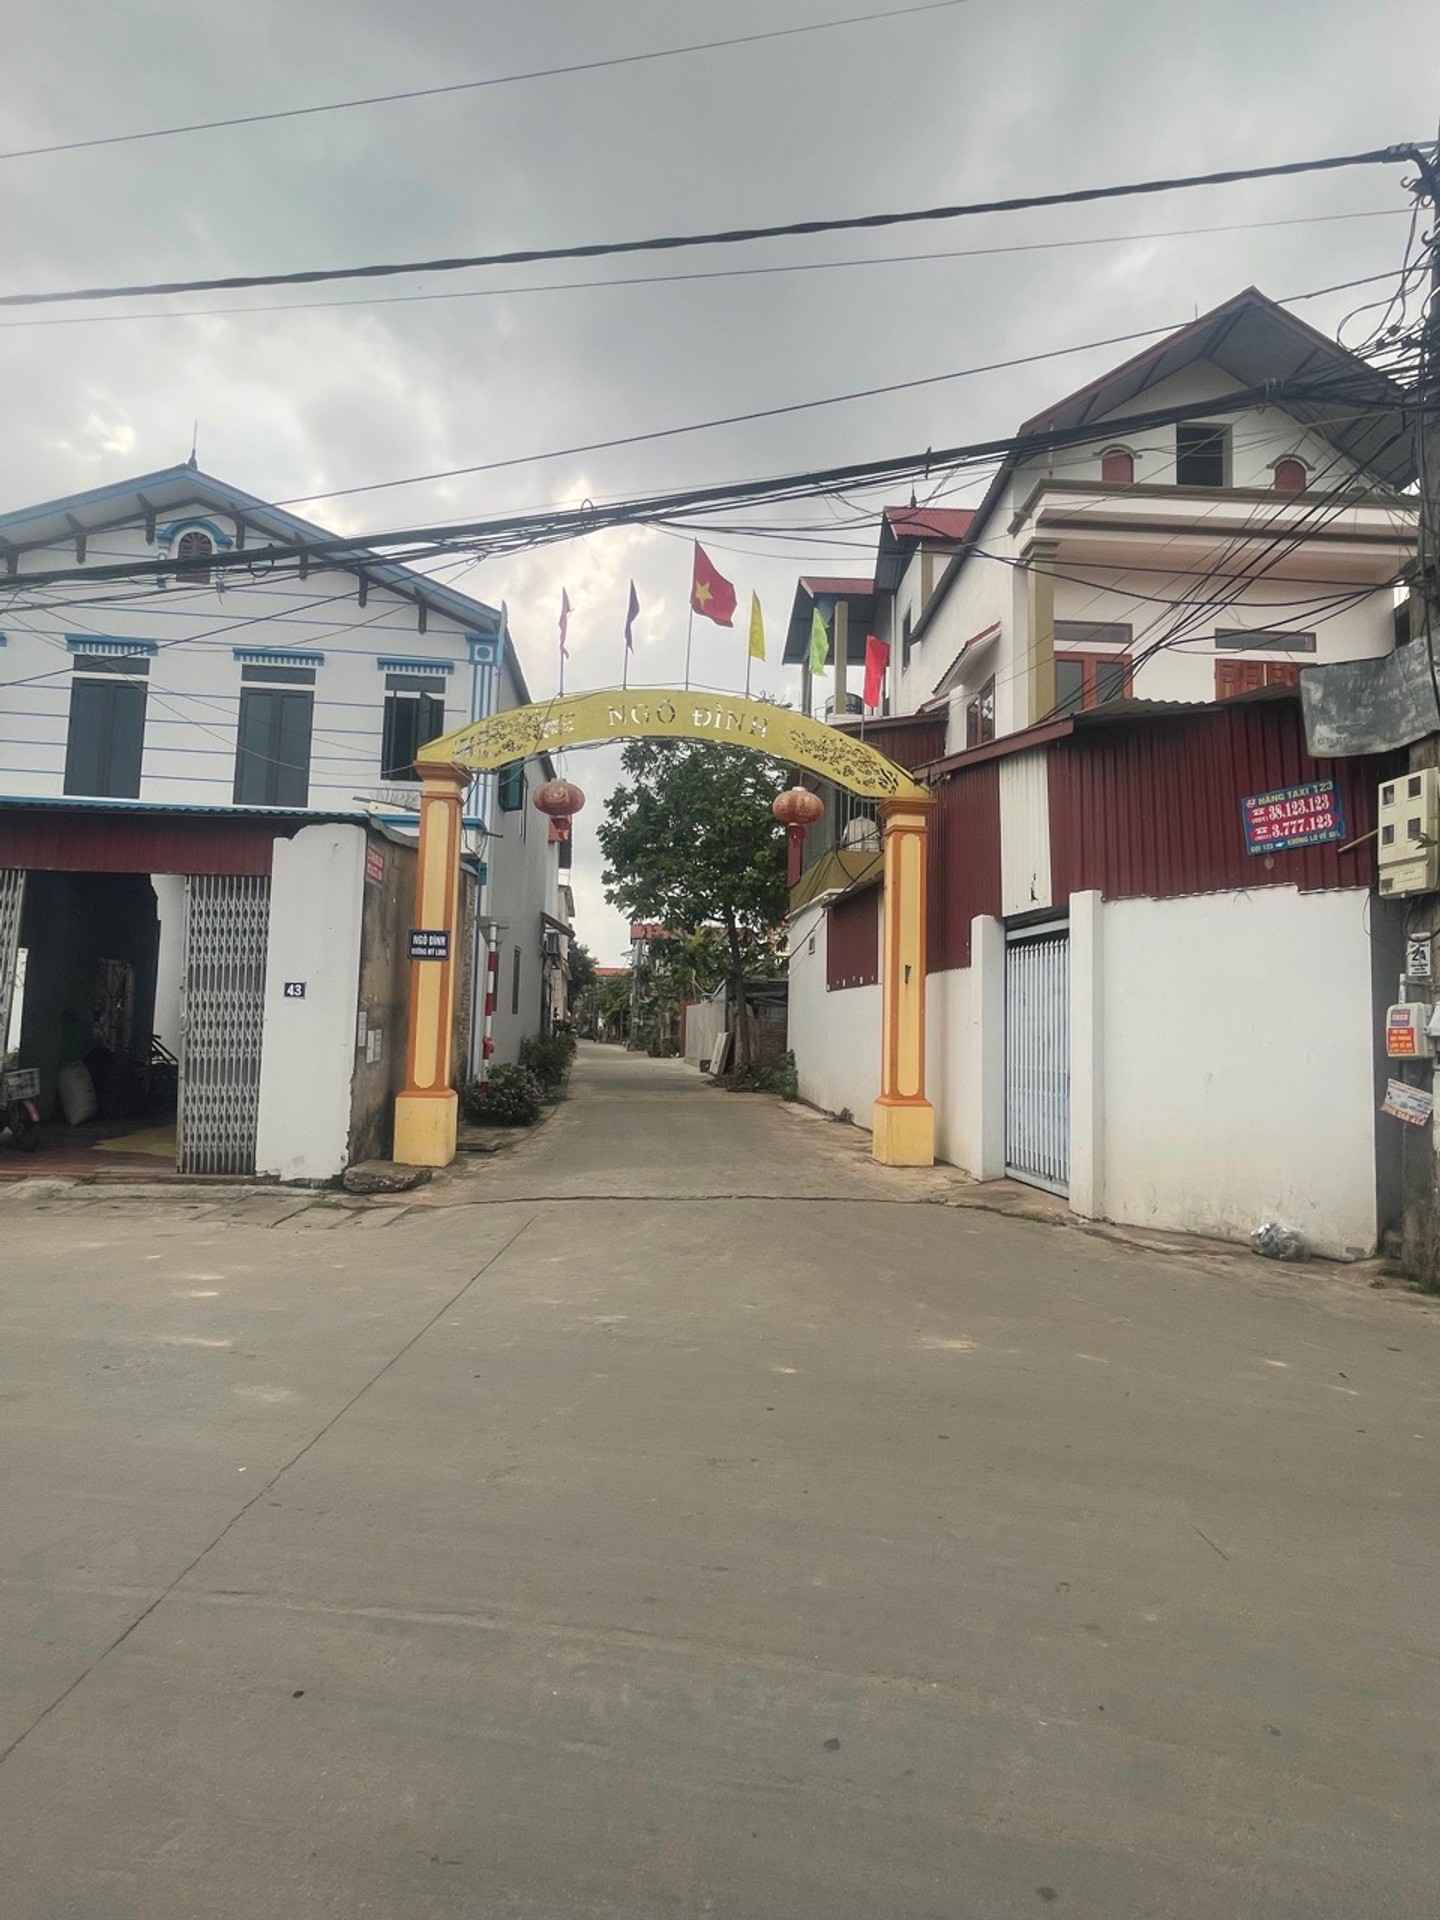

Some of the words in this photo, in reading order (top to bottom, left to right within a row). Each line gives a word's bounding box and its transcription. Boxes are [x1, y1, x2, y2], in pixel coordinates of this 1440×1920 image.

[692, 702, 769, 738] ĐÌNH
[1287, 787, 1310, 799] TAXI
[1313, 781, 1333, 793] 123
[1268, 794, 1330, 820] 38.123.123
[1271, 813, 1333, 838] 3.777.123
[286, 984, 302, 996] 43
